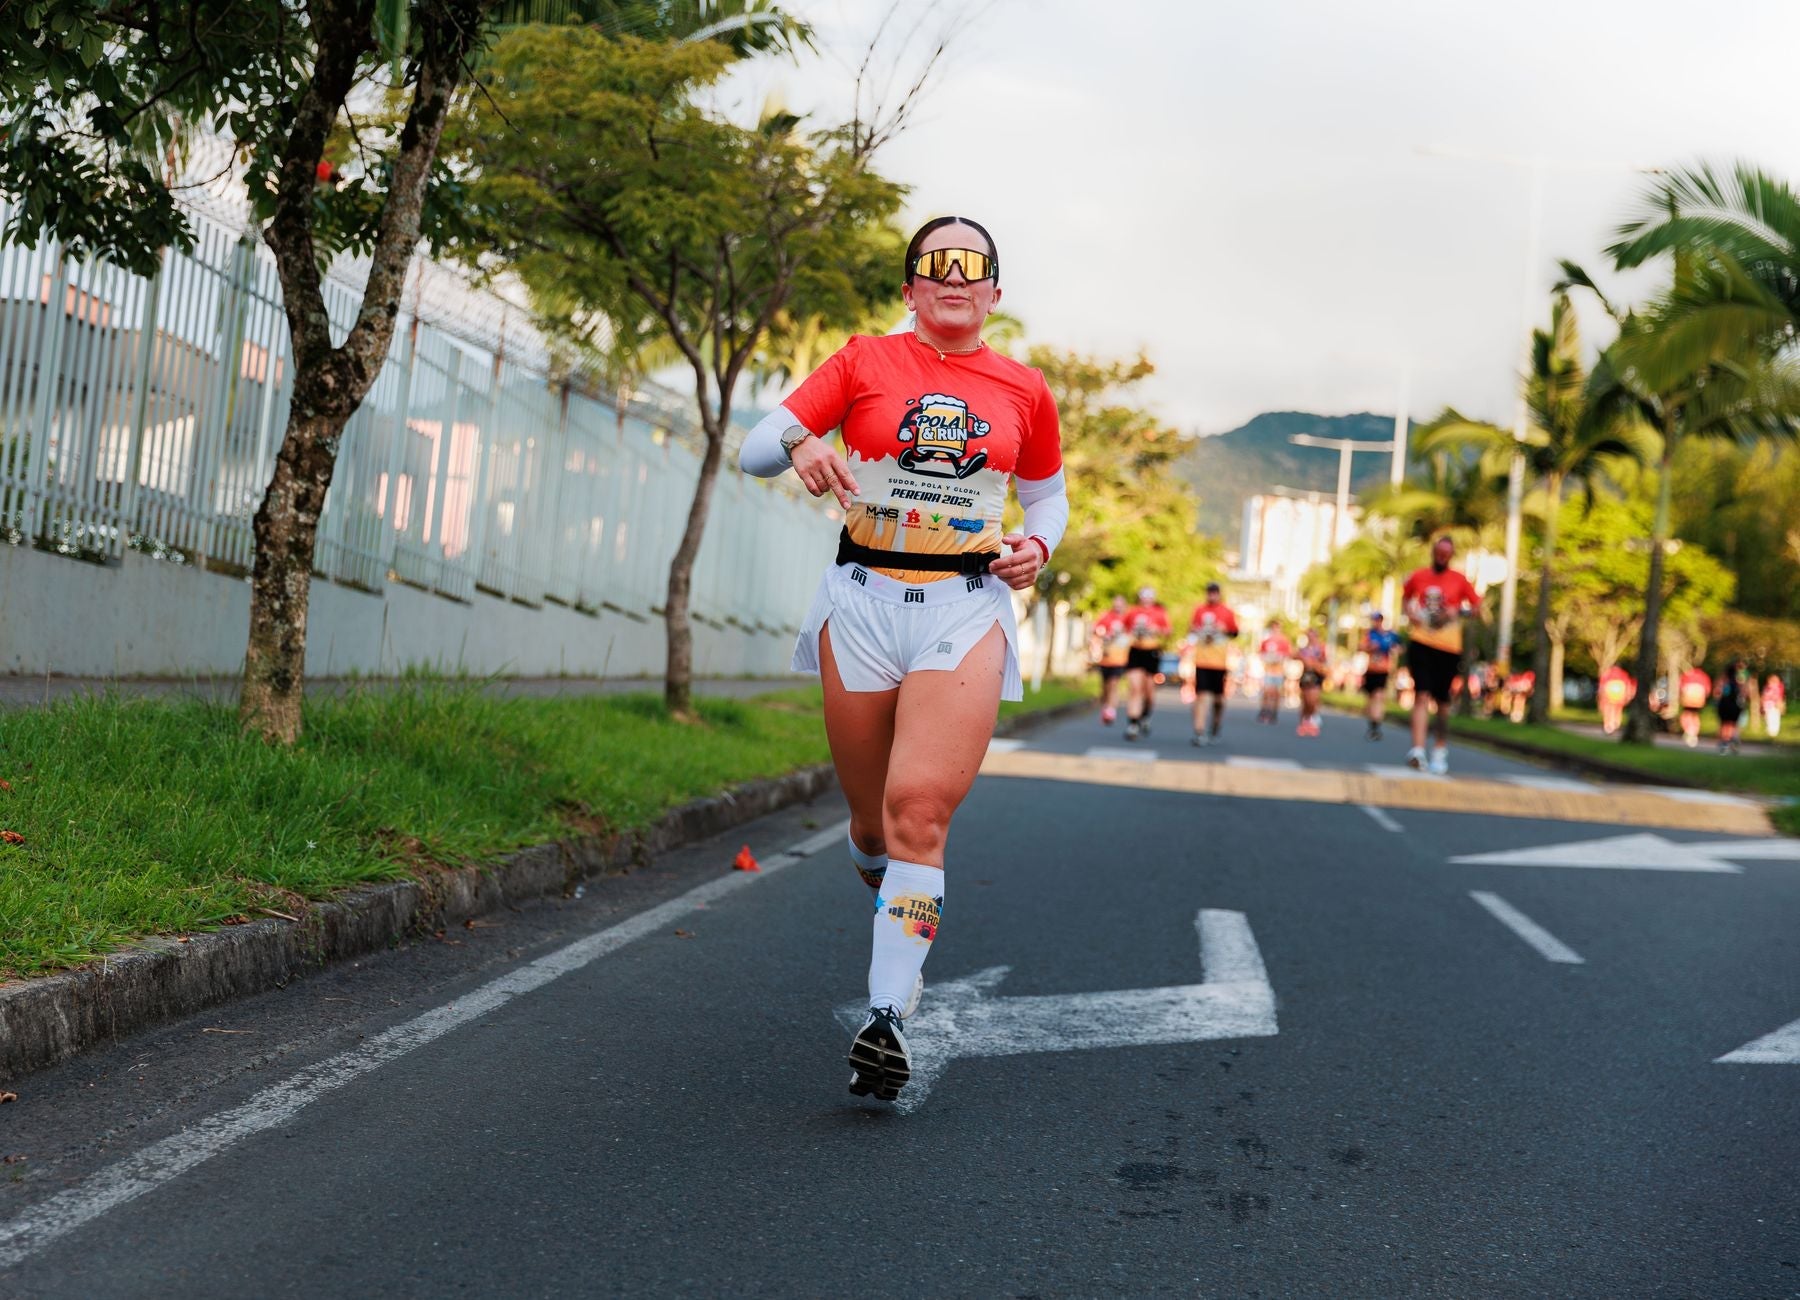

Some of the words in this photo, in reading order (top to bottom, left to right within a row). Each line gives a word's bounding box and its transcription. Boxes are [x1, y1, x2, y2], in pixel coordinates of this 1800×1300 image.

[916, 415, 961, 429] POLA
[922, 427, 935, 441] &
[936, 427, 967, 441] RUN
[888, 478, 917, 487] SUDOR,
[921, 482, 942, 490] POLA
[953, 487, 981, 496] GLORIA
[890, 488, 941, 503] PEREIRA
[941, 494, 974, 508] 2025
[908, 909, 938, 927] HARD
